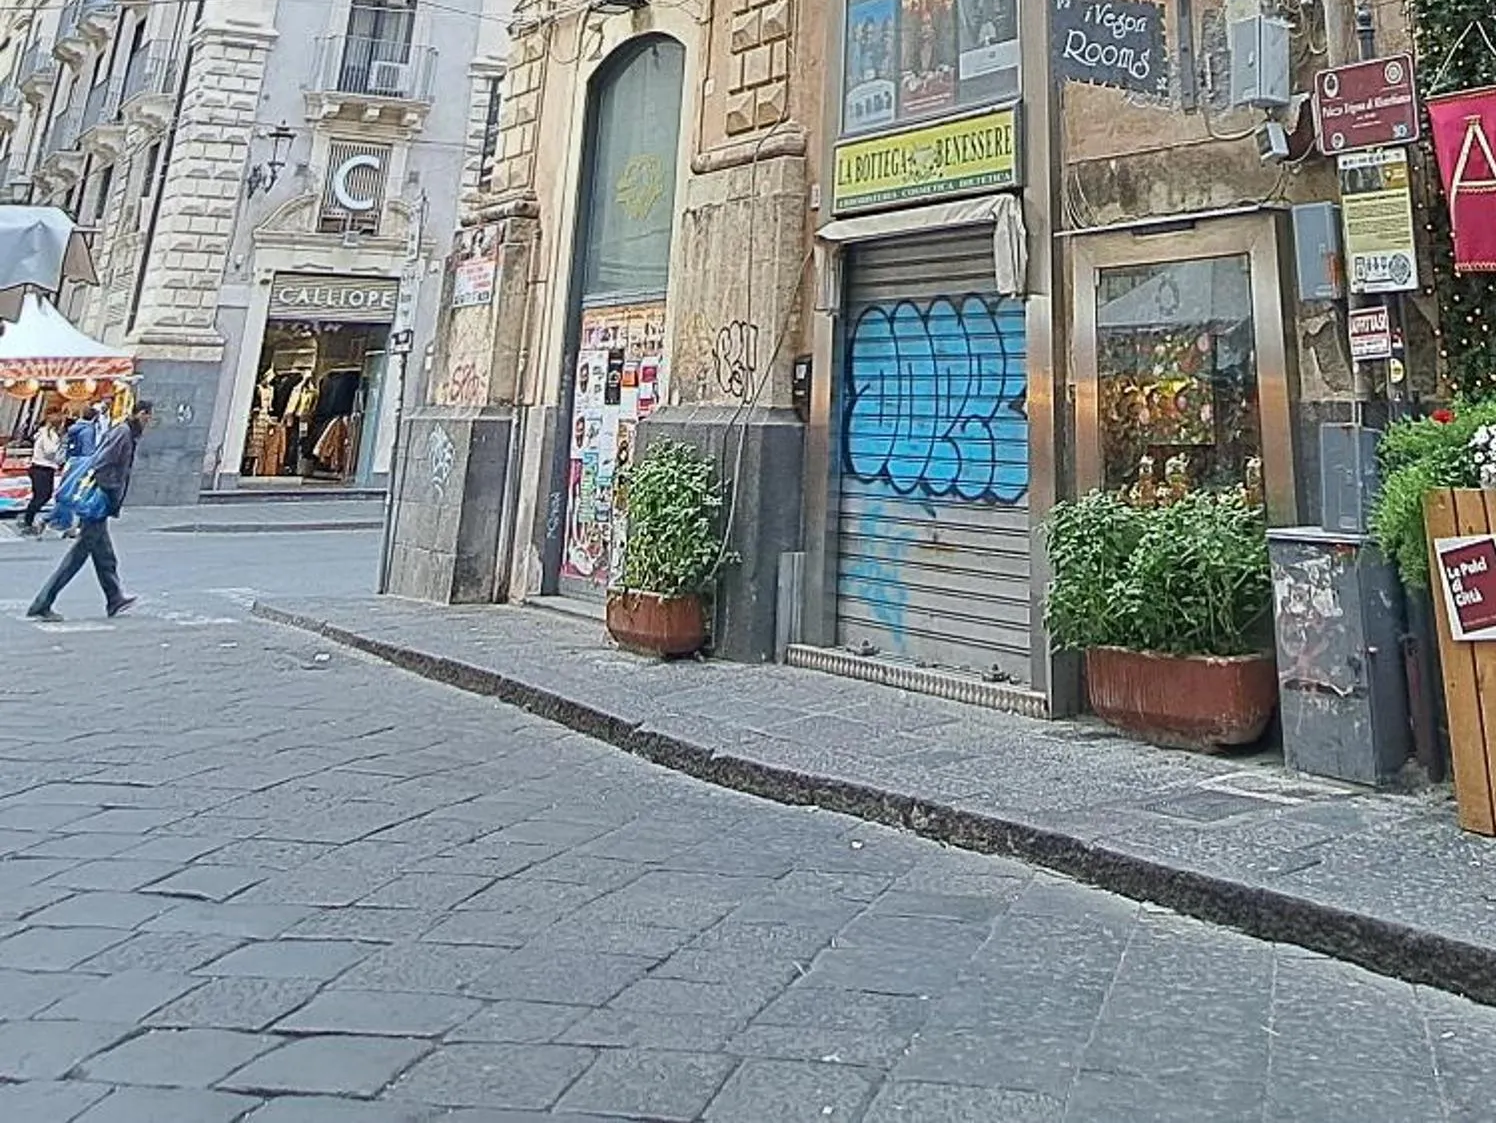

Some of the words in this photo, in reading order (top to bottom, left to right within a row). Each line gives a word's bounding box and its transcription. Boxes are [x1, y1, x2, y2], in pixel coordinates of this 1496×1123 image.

[838, 158, 851, 186] LA
[855, 148, 907, 183] BOTTEGA
[936, 124, 1013, 169] BENESSERE
[280, 286, 395, 308] CALLIOPE
